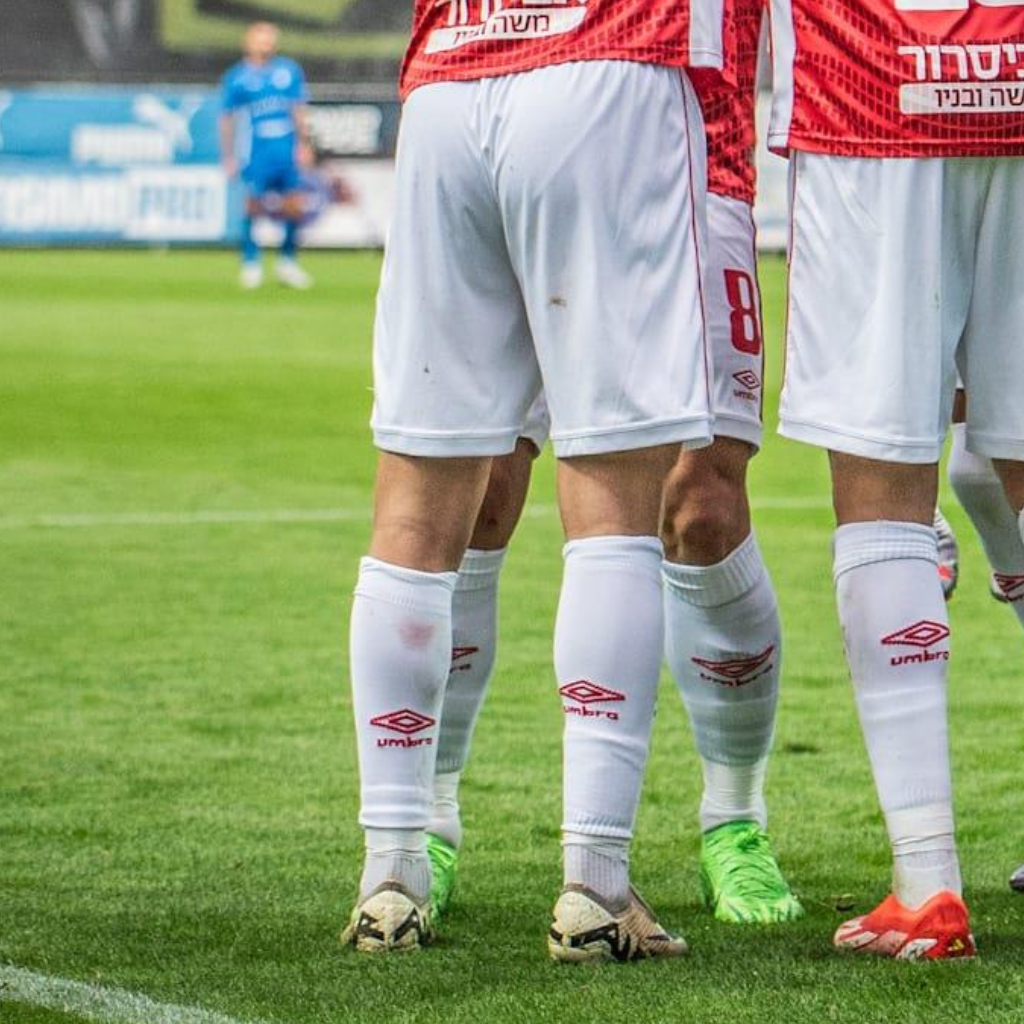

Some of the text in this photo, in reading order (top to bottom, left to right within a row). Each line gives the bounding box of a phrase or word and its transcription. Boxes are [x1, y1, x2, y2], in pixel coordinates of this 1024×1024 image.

[493, 15, 550, 33] משה
[935, 89, 983, 107] ובניו
[724, 269, 761, 355] 8
[377, 736, 433, 749] umbro
